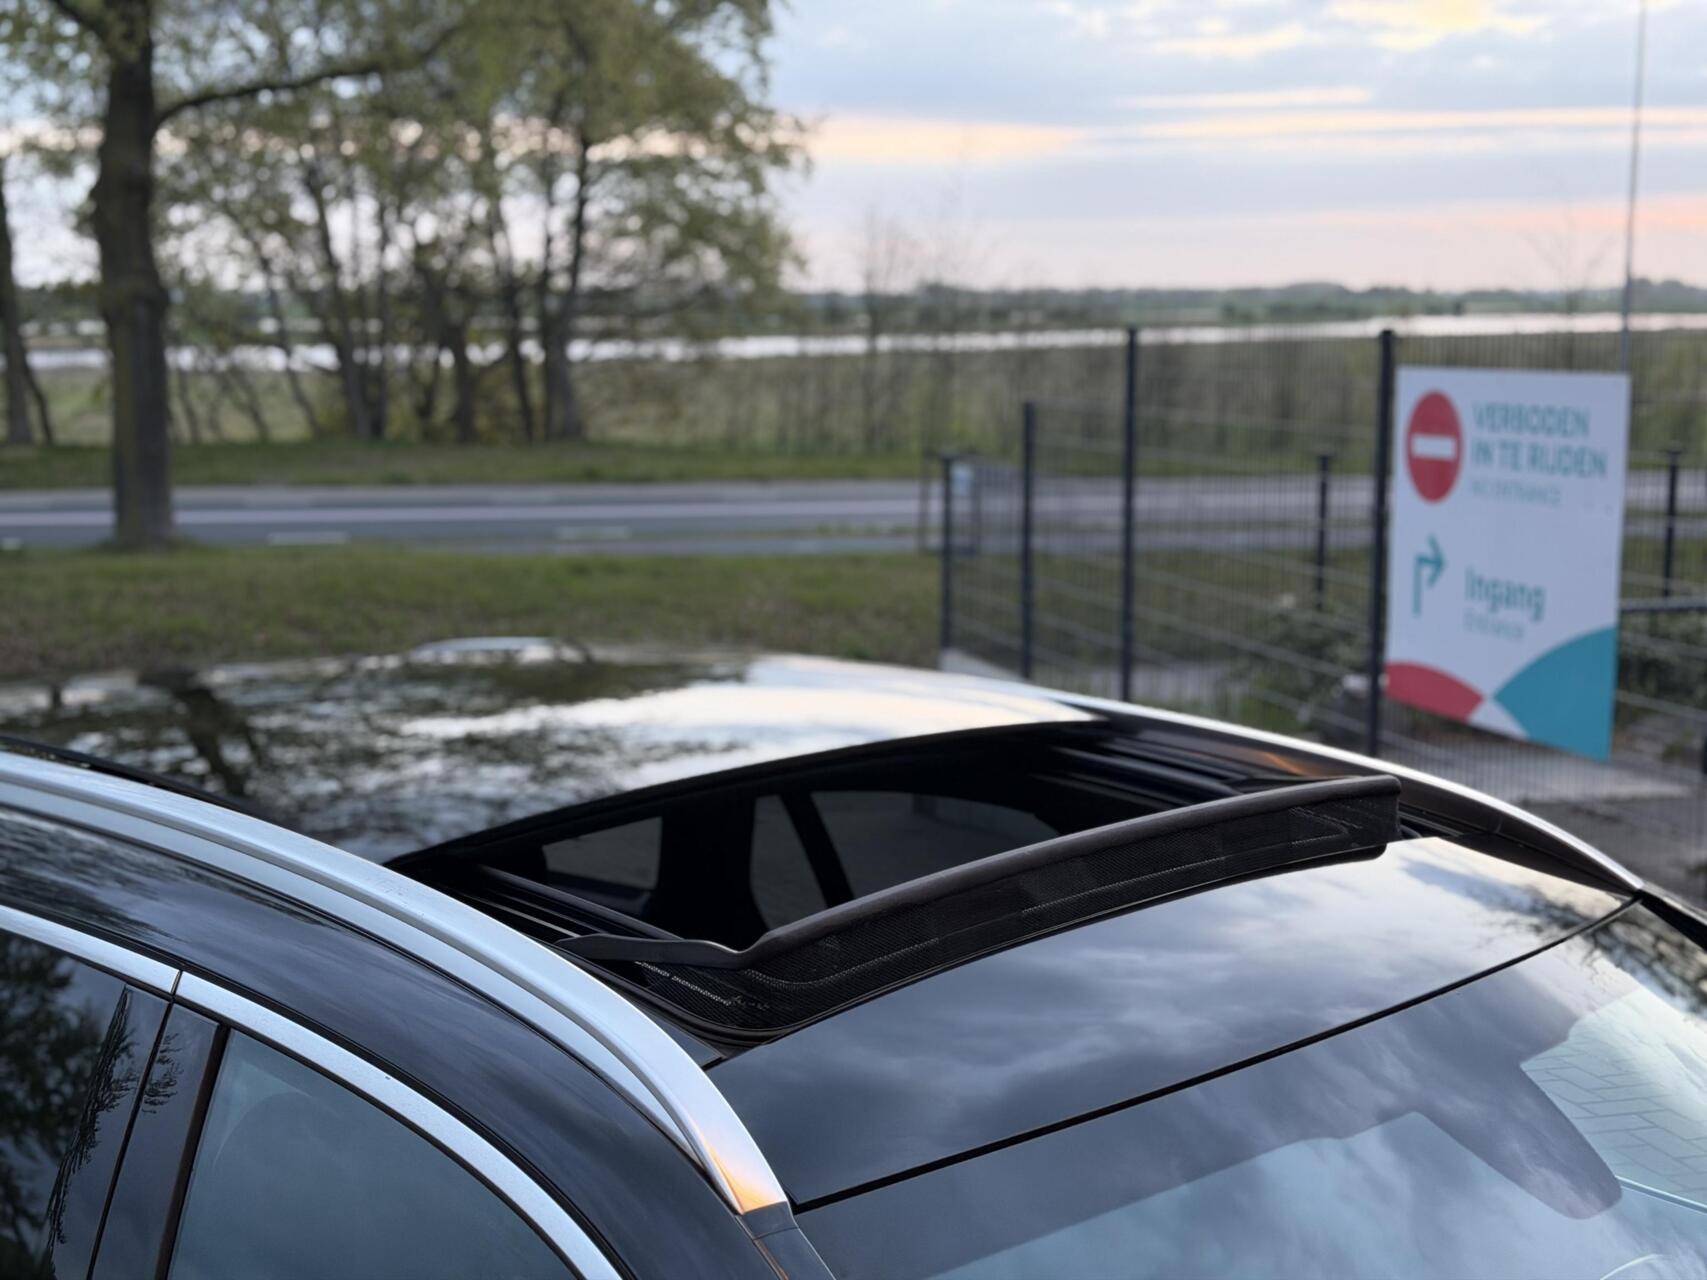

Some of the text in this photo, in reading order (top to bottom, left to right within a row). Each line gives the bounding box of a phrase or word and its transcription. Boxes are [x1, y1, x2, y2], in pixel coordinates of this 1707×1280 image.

[1472, 402, 1590, 438] VERBODEN
[1473, 439, 1494, 466] IN
[1499, 439, 1522, 472] TE
[1465, 566, 1546, 623] Ingang
